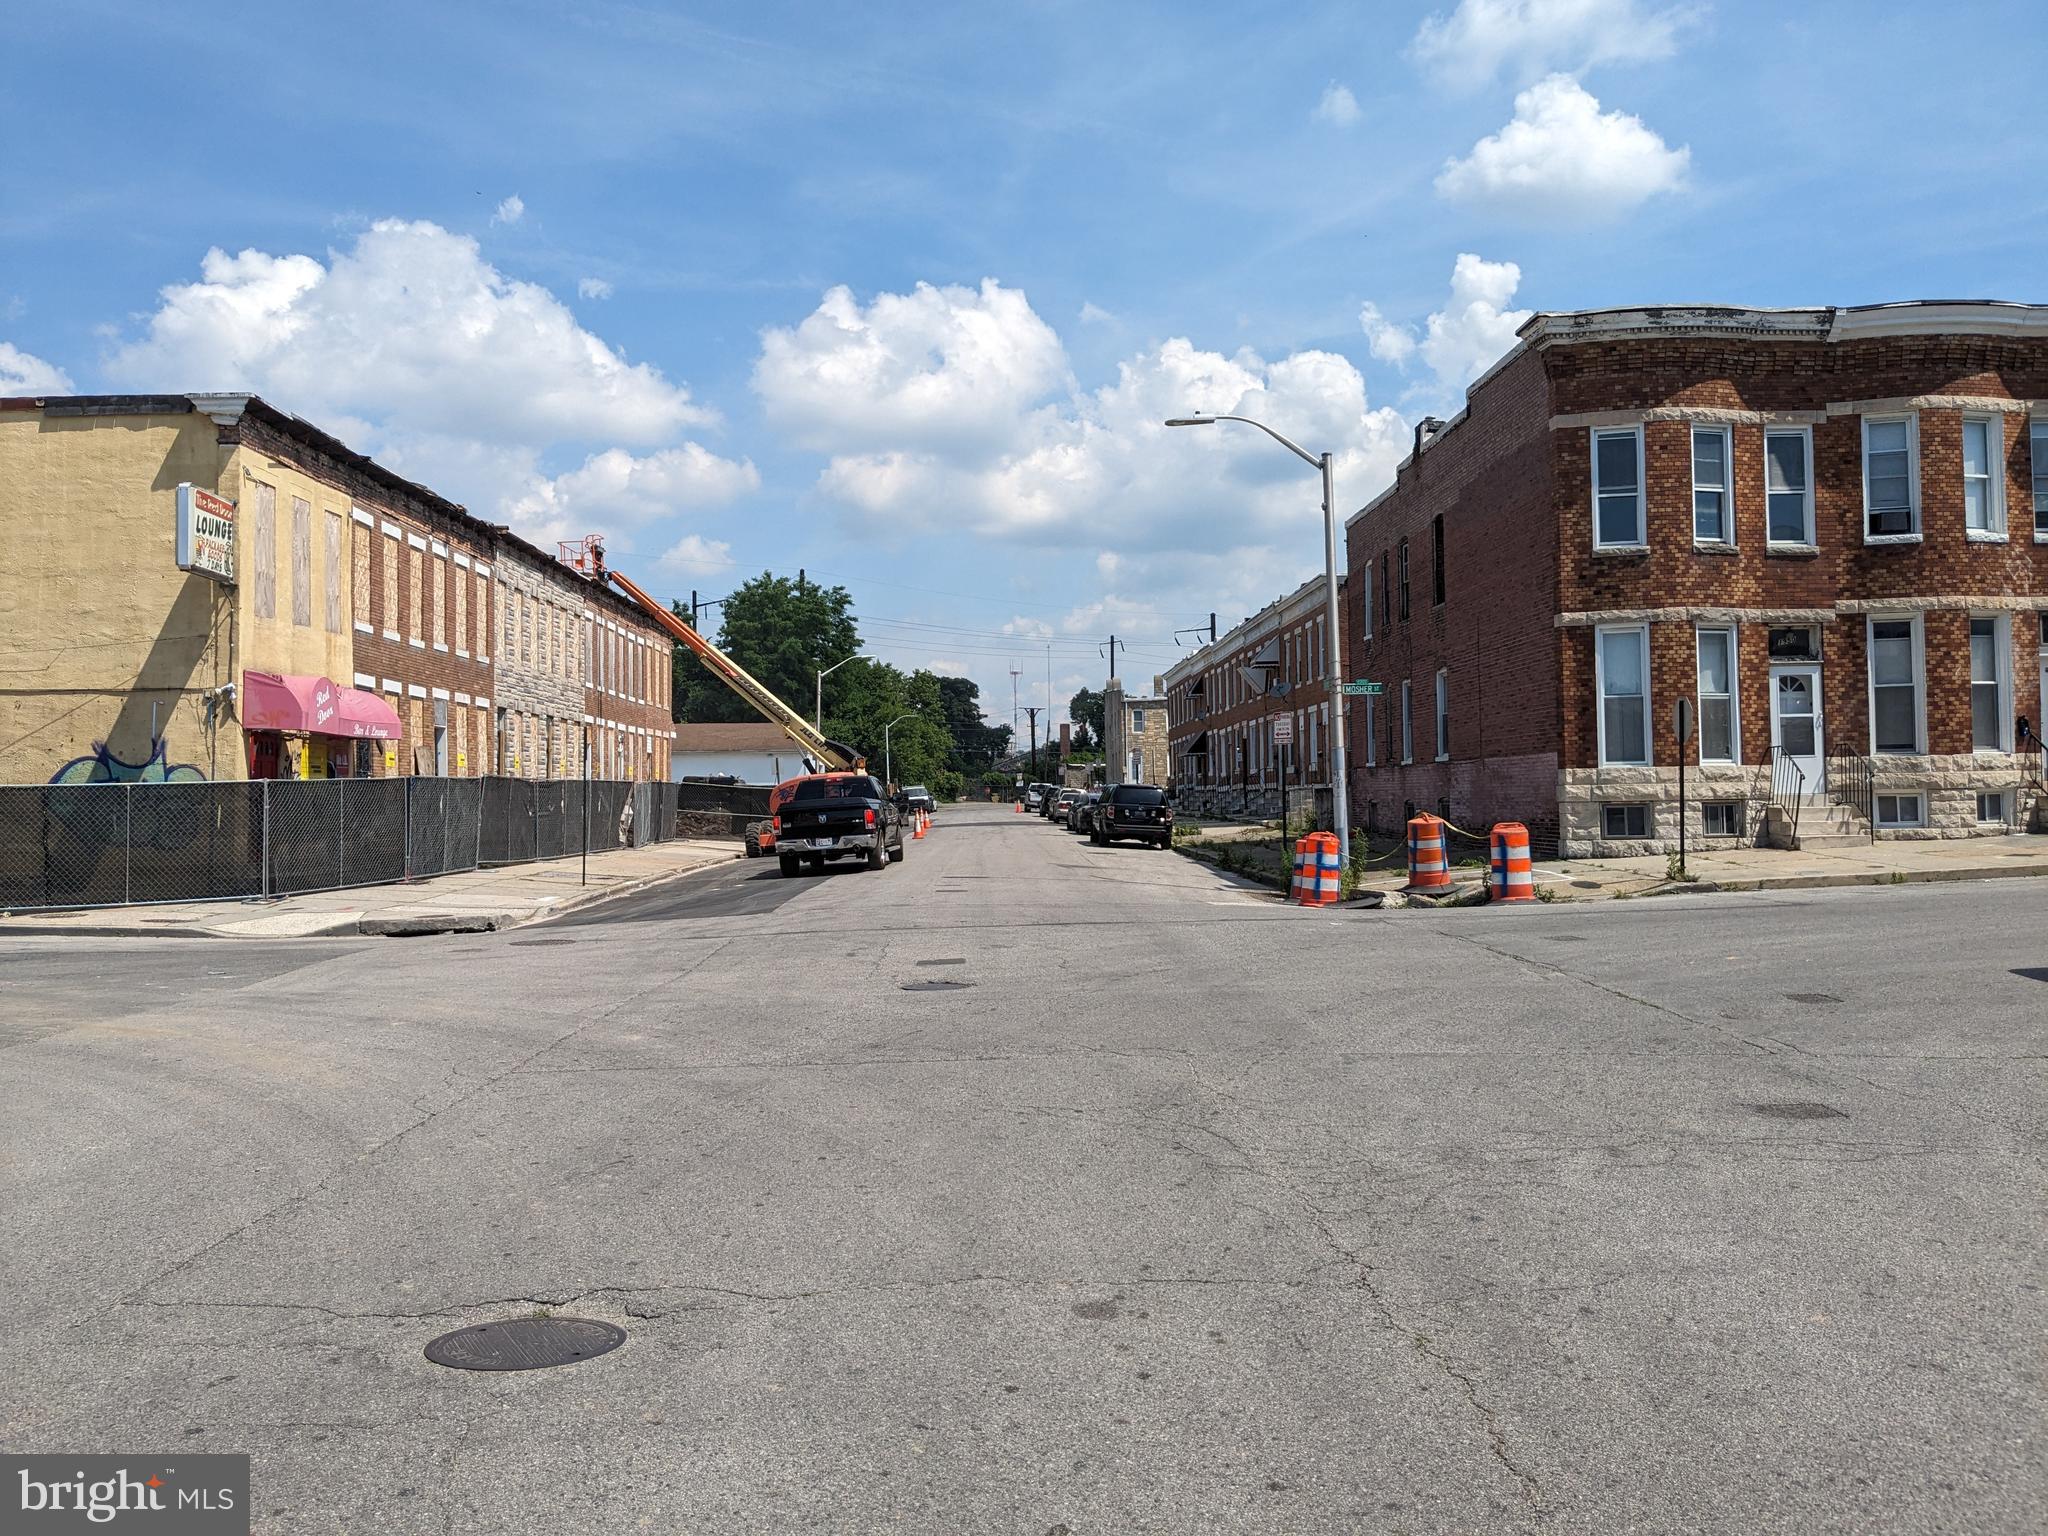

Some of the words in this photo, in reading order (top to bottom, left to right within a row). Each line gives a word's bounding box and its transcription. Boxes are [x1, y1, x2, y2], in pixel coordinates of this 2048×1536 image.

[196, 514, 232, 540] LOUNGE
[316, 685, 330, 707] Red
[1345, 685, 1372, 693] MOSHER
[317, 706, 334, 725] Door
[353, 723, 363, 736] Bar
[365, 725, 370, 736] &
[371, 725, 388, 738] Lounge
[800, 728, 815, 739] JLG
[814, 739, 828, 752] LIFT
